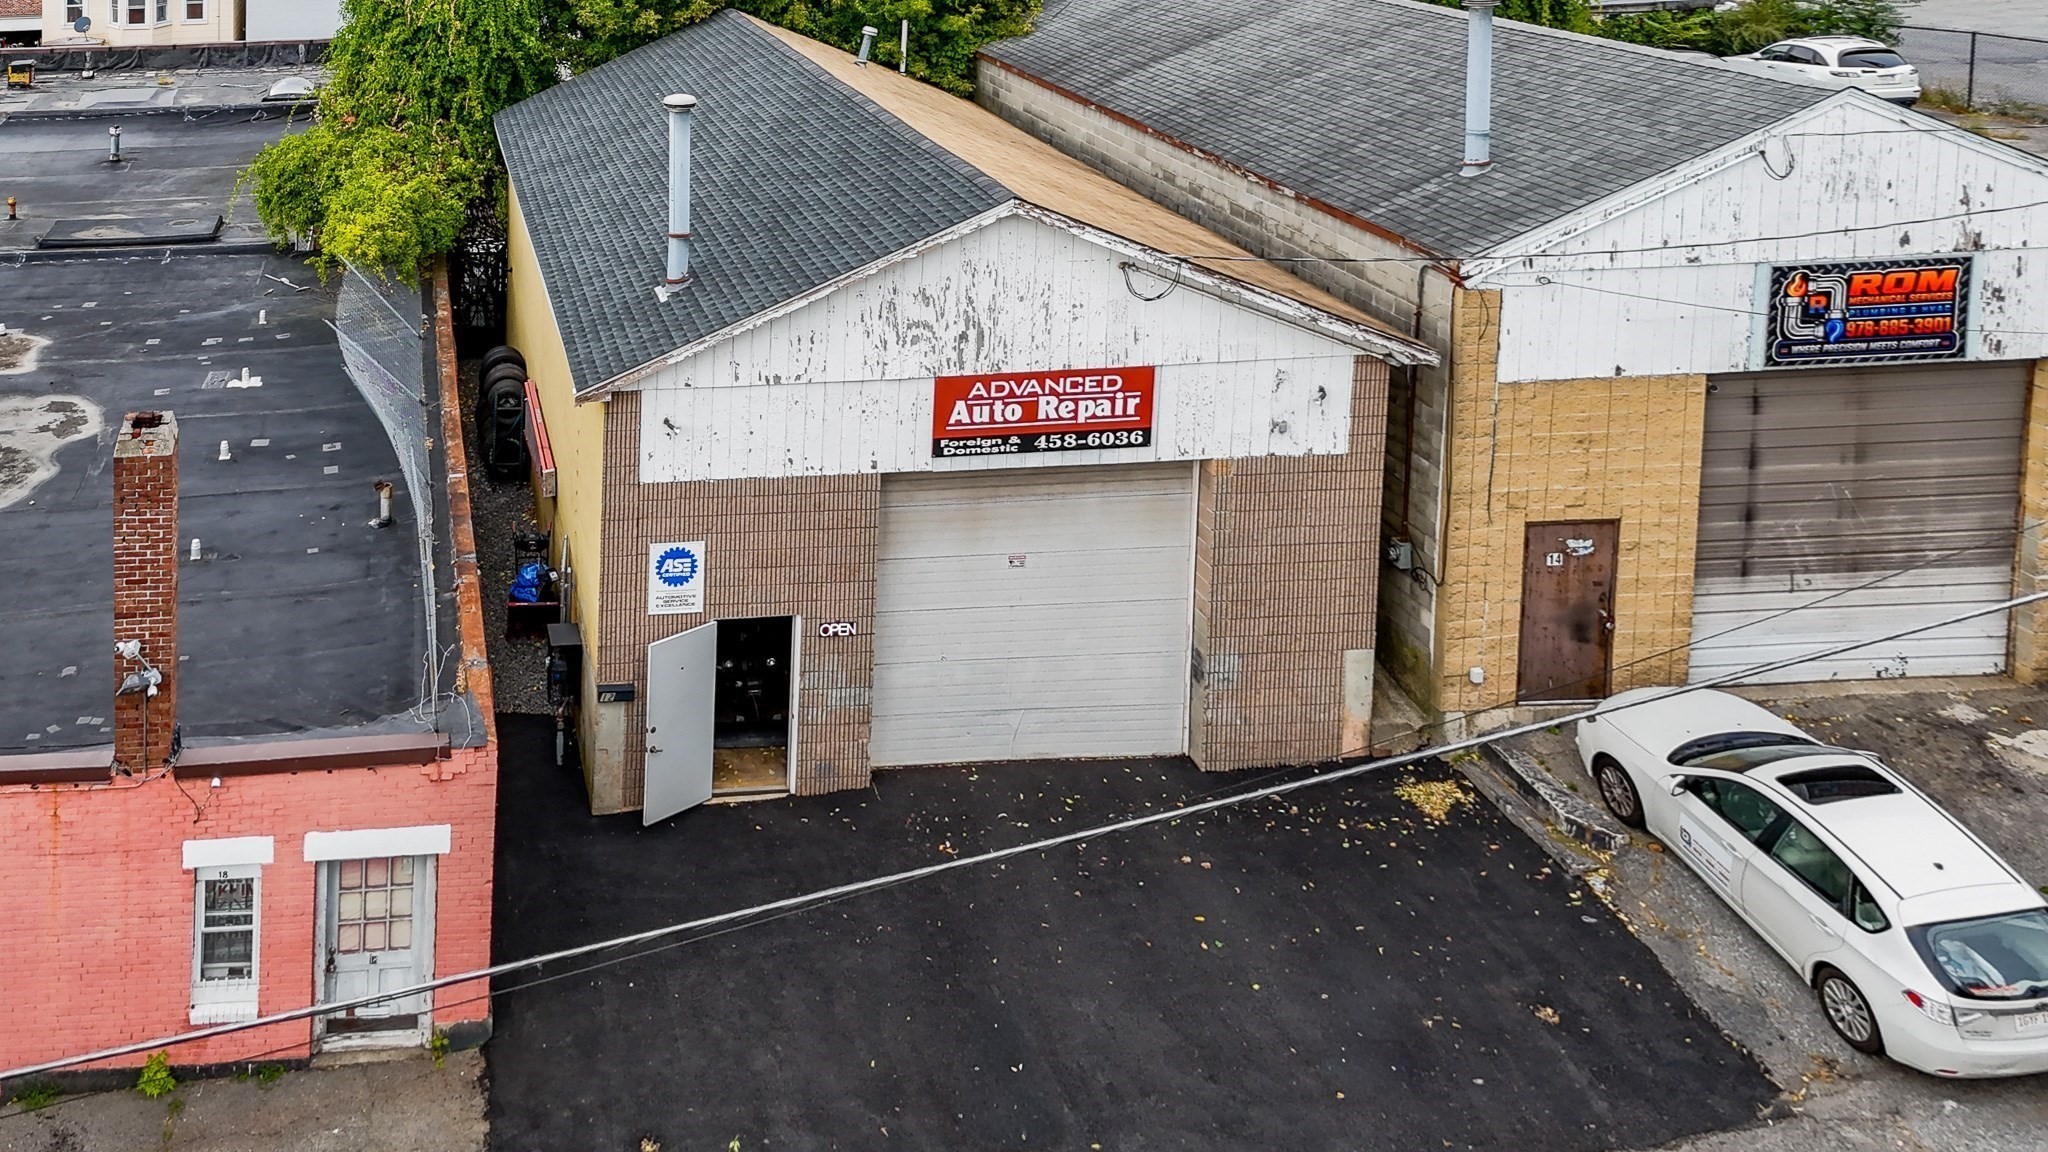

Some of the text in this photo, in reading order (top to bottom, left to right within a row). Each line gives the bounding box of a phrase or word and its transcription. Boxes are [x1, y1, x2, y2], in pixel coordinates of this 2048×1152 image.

[1849, 269, 1958, 296] ROM
[1809, 296, 1827, 313] R
[1848, 292, 1953, 305] MECHANICAL SERVICES
[1849, 307, 1906, 316] PLUMBING
[1922, 304, 1951, 313] HVAC
[1791, 339, 1941, 354] WHERE PRECISION MEETS COMFORT
[968, 375, 1122, 398] ADVANCED
[948, 392, 1141, 424] Auto Repair
[940, 436, 1021, 448] Foreign &
[1034, 431, 1143, 449] 458-6036
[943, 445, 1018, 456] Domestic
[660, 558, 692, 573] ASE
[1549, 554, 1561, 565] 14
[820, 622, 857, 637] OPEN
